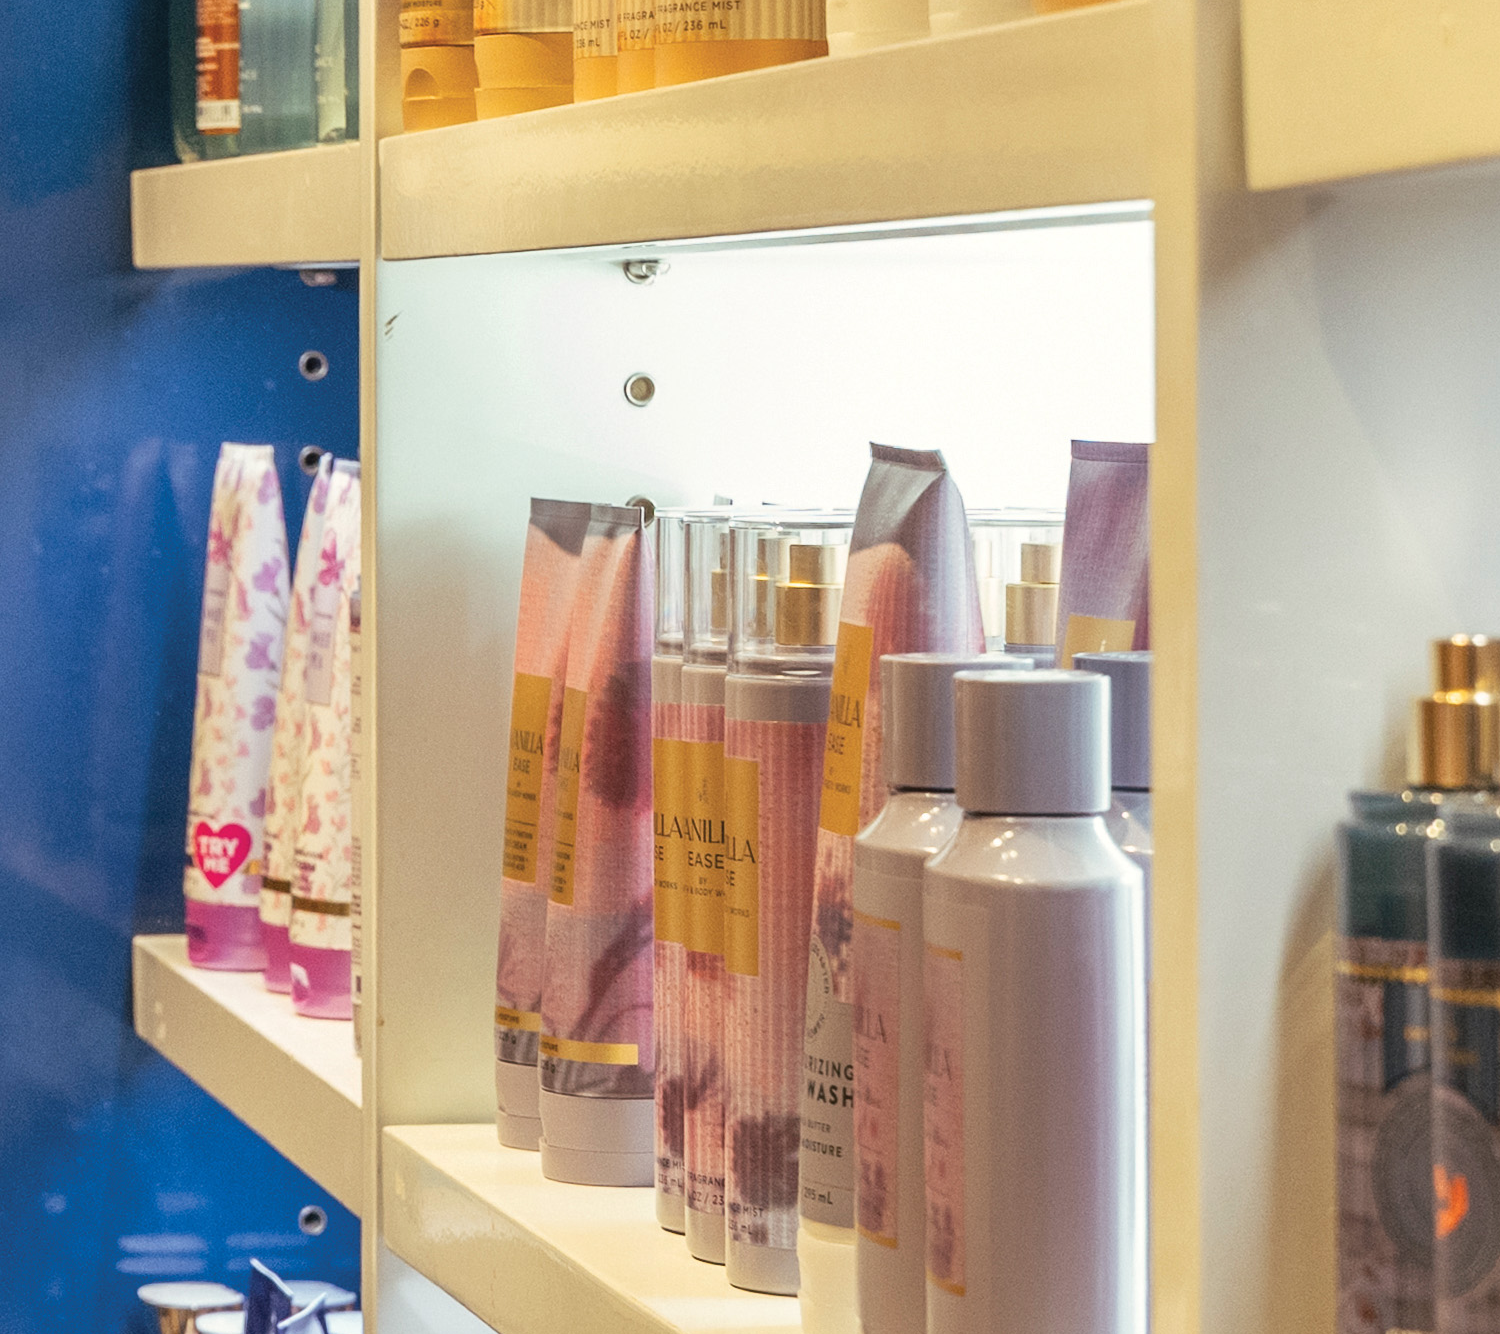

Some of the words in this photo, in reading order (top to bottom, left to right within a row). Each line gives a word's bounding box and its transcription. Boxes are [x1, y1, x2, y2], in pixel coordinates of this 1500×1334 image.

[711, 0, 742, 13] MIST
[587, 18, 611, 30] MIST
[623, 9, 655, 23] FRAGRA
[683, 19, 704, 32] 236
[708, 19, 727, 30] mL
[198, 834, 240, 858] TRY
[687, 850, 726, 870] EASE
[806, 1055, 855, 1082] RIZING
[806, 1077, 855, 1110] WASH
[818, 1189, 834, 1207] mL
[742, 1203, 765, 1218] MIST
